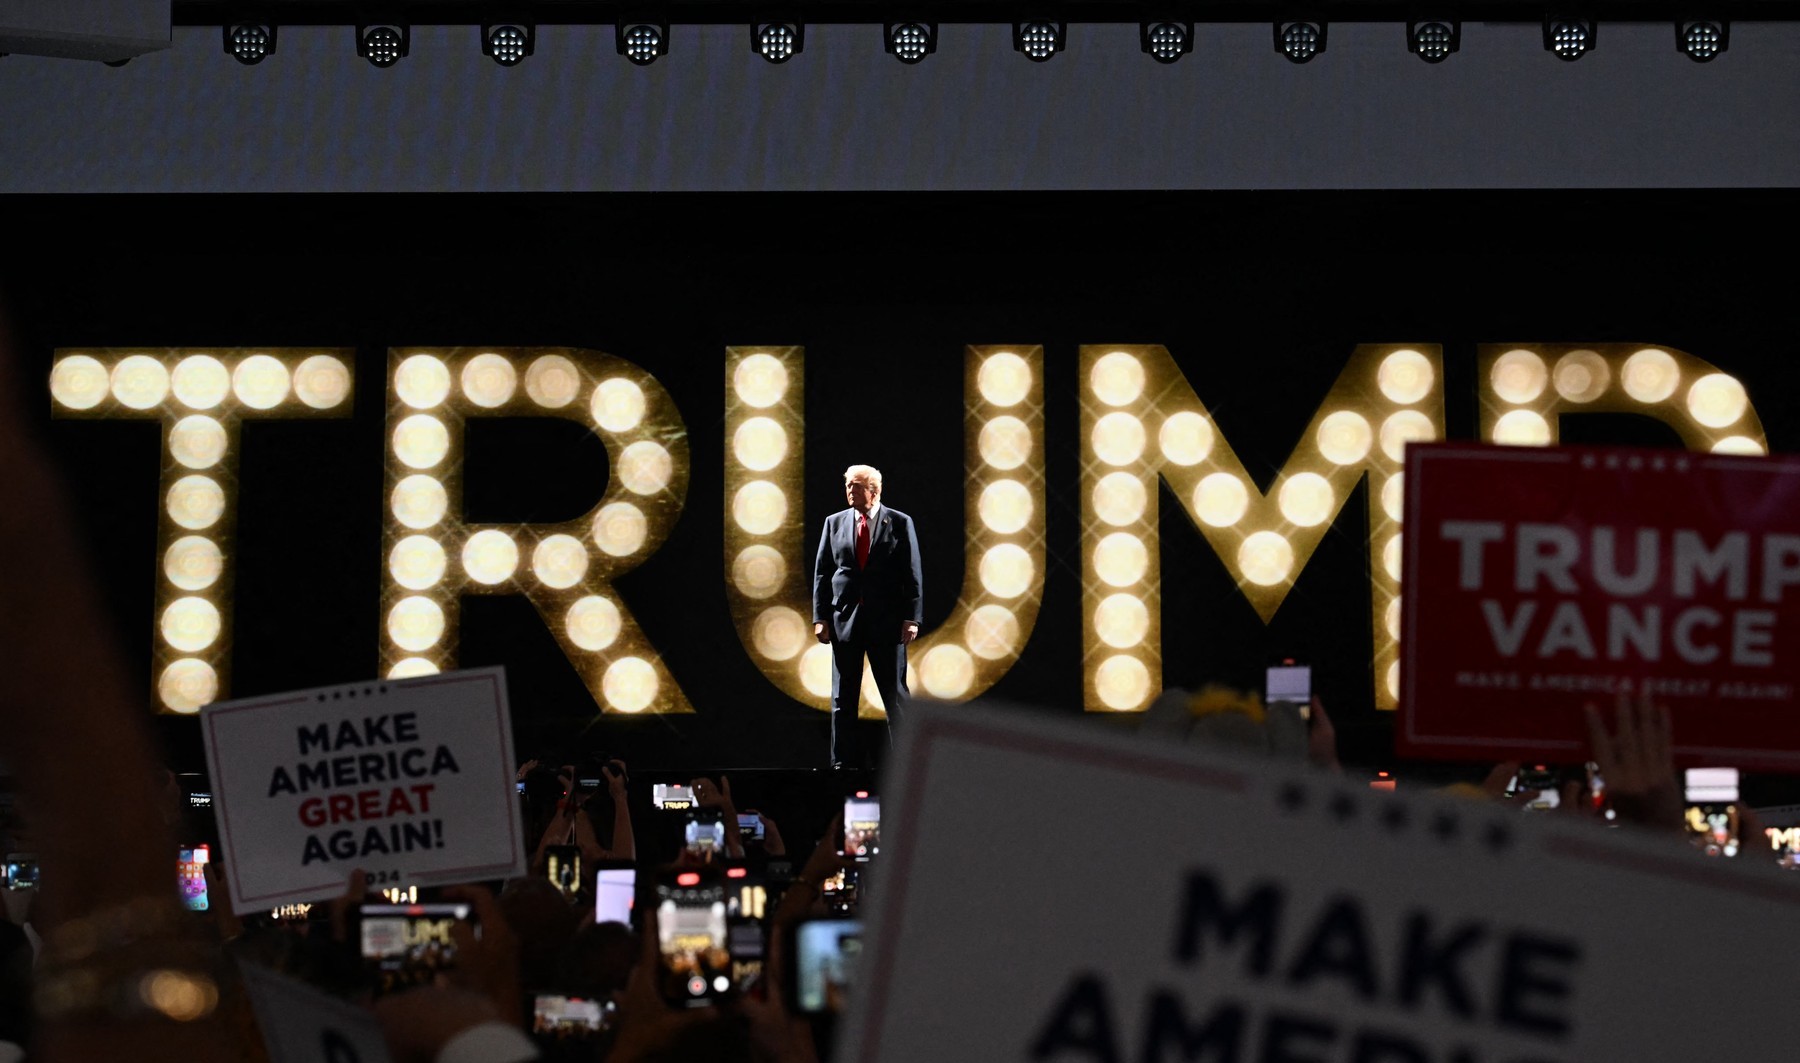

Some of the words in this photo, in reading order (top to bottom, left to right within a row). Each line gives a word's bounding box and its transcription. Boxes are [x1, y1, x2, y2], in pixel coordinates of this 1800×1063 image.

[1482, 600, 1777, 667] VANCE
[1455, 671, 1521, 690] MAKE
[297, 712, 419, 756] MAKE
[268, 745, 460, 798] AMERICA
[298, 784, 434, 828] GREAT
[302, 819, 445, 867] AGAIN!
[365, 870, 400, 886] 024
[1172, 864, 1584, 1040] MAKE
